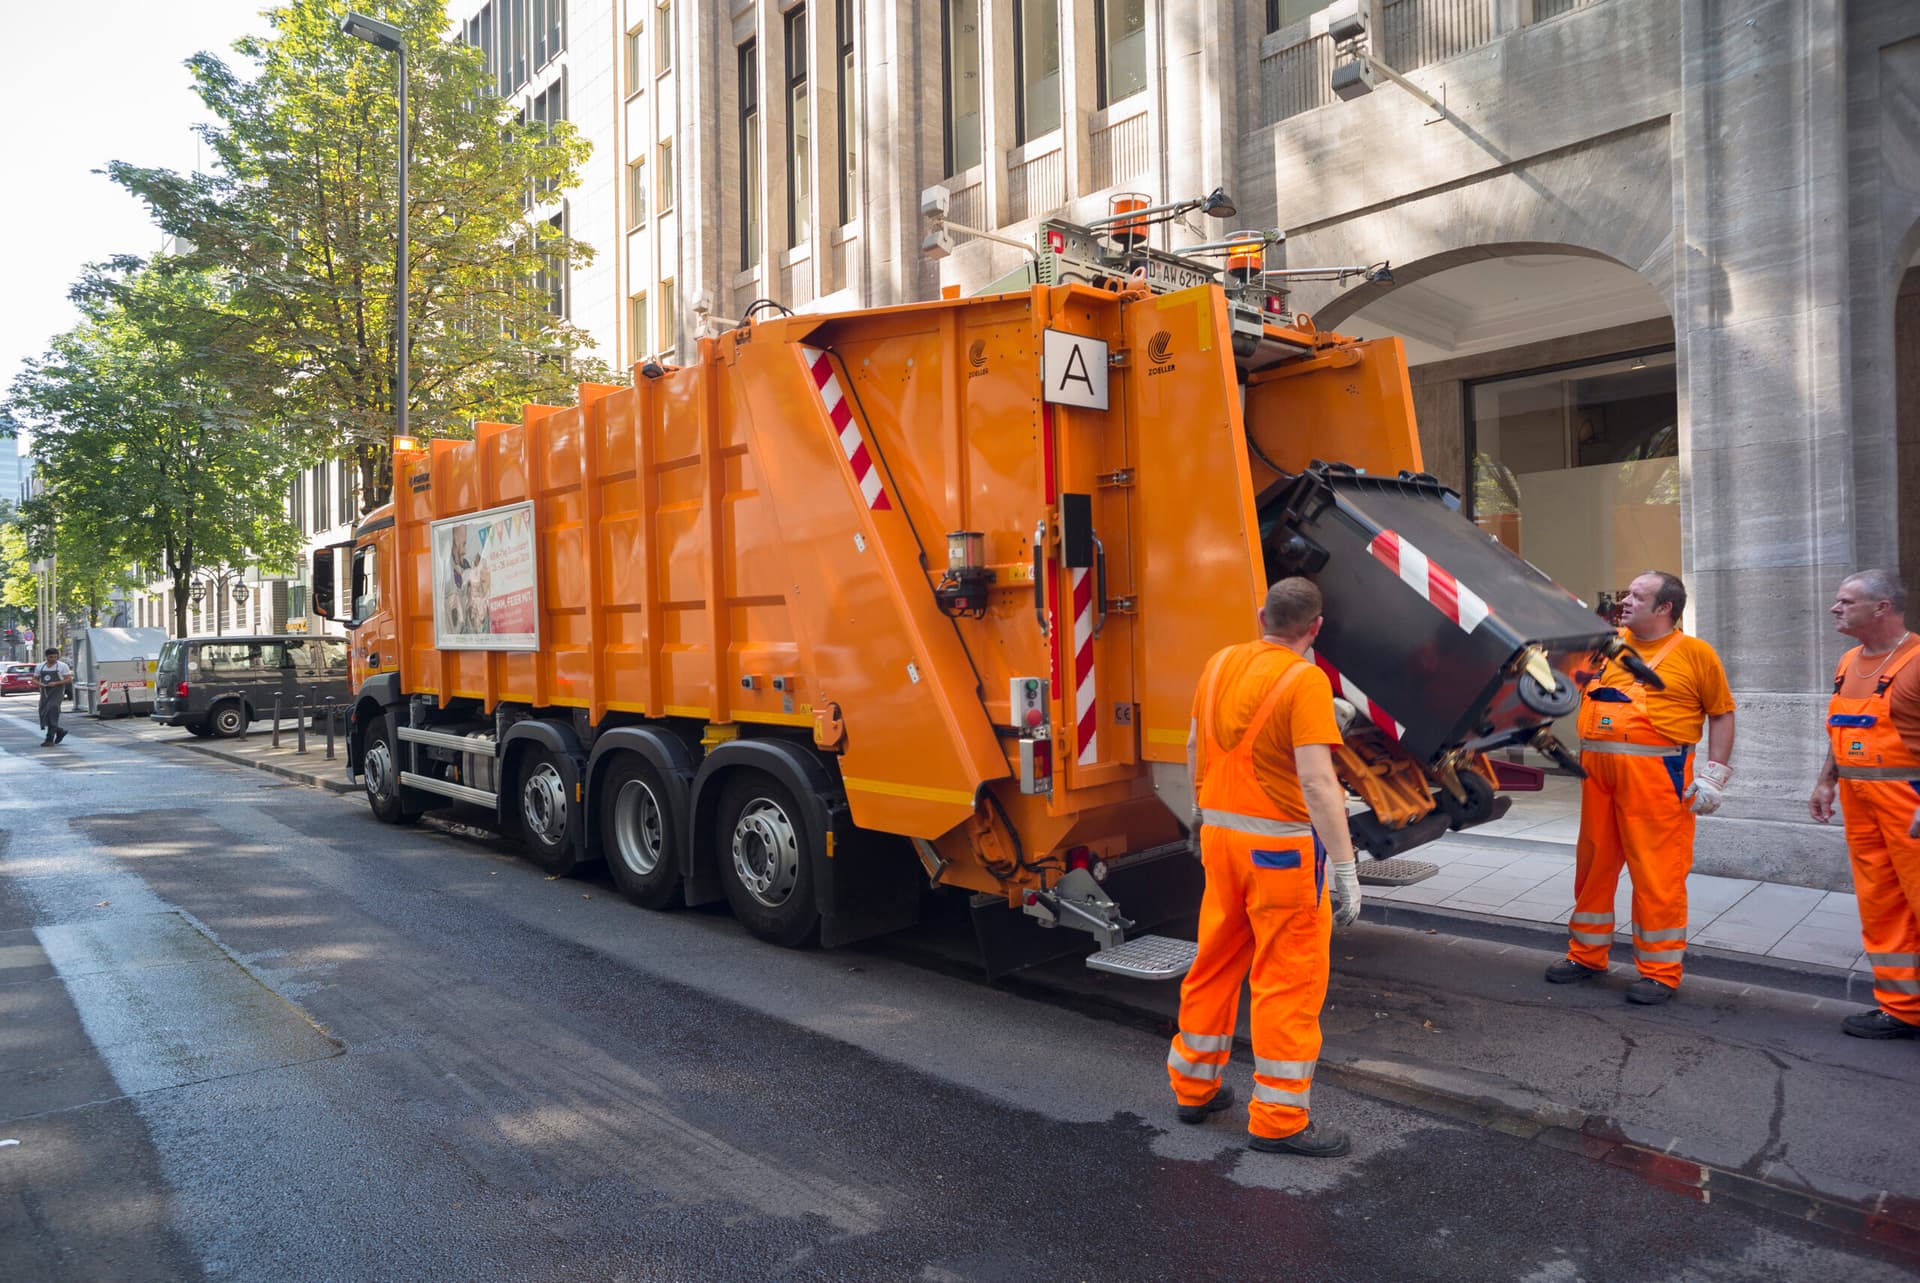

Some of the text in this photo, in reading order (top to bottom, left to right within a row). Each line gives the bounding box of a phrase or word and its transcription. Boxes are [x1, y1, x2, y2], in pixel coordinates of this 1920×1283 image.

[1149, 261, 1156, 278] D
[1163, 265, 1178, 284] AW
[968, 367, 989, 379] ZOELLER
[1059, 343, 1095, 396] A
[1148, 364, 1176, 376] ZOELLER
